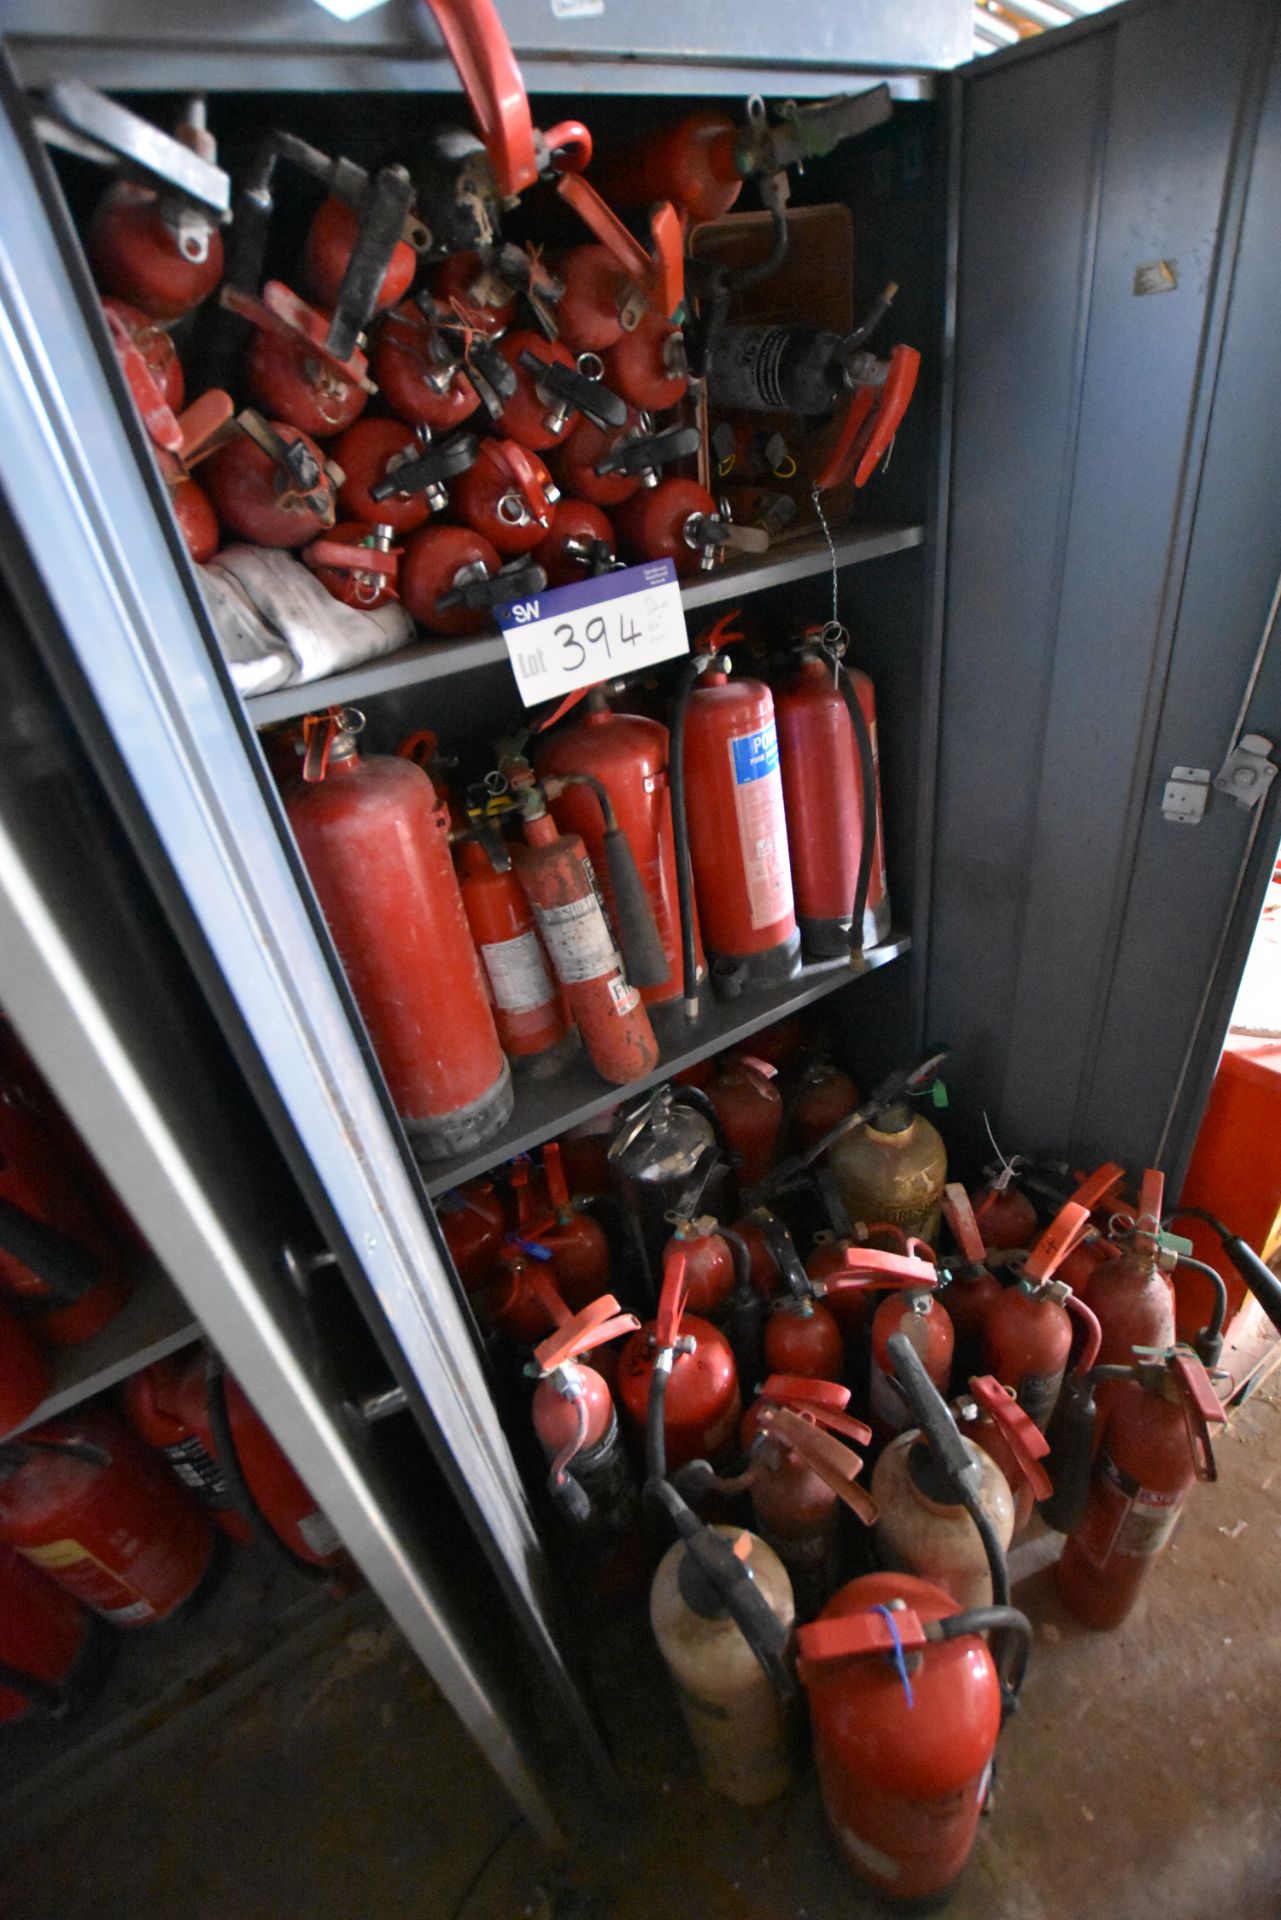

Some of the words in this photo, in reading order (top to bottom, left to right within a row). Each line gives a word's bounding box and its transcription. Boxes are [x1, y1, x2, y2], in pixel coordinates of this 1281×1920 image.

[511, 600, 541, 623] SW
[517, 648, 548, 680] Lot
[554, 613, 642, 672] 394
